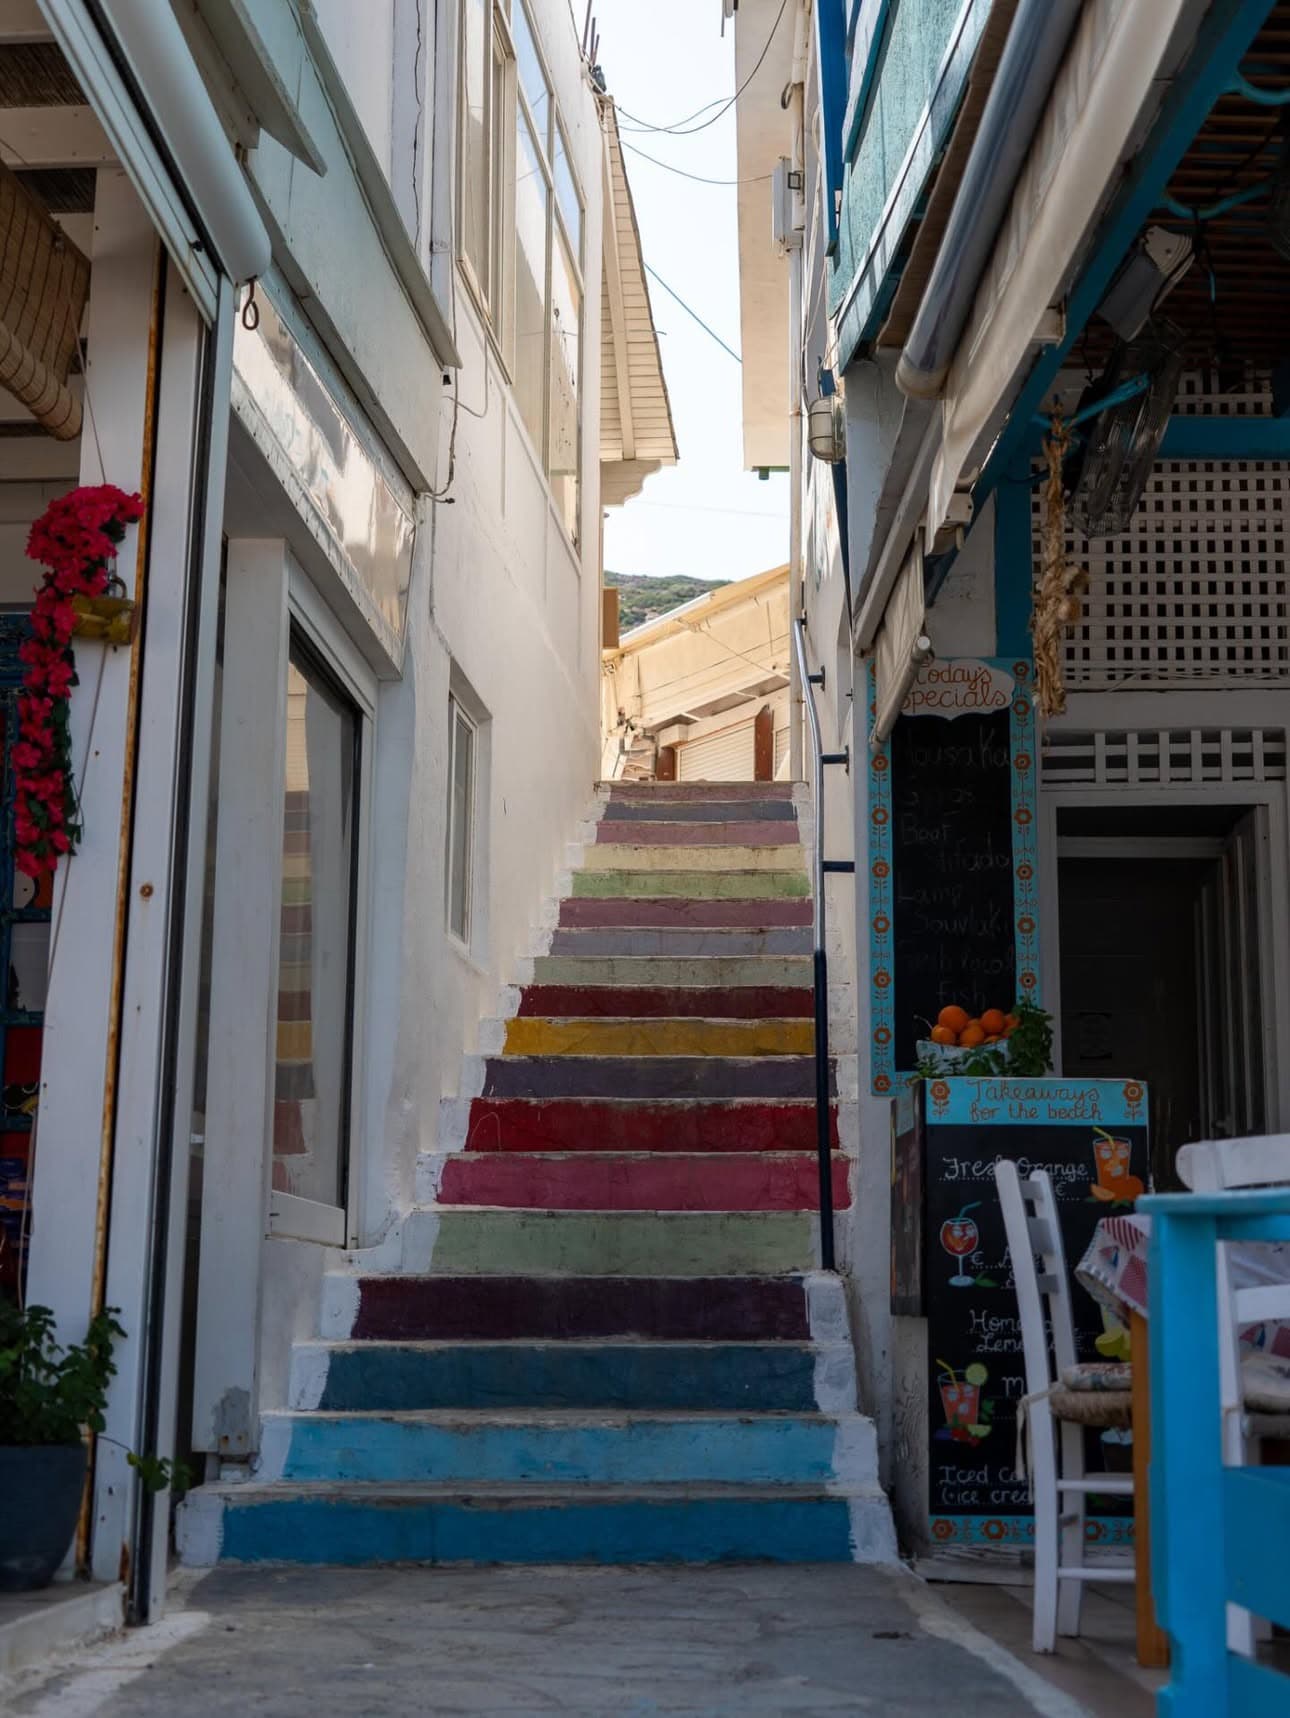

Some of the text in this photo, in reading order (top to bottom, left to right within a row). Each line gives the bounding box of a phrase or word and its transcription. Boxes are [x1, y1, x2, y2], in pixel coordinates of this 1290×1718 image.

[966, 1079, 1100, 1109] Takeaways
[969, 1101, 1103, 1122] for the beach
[942, 1154, 1002, 1180] Fres
[937, 1464, 989, 1487] Iced
